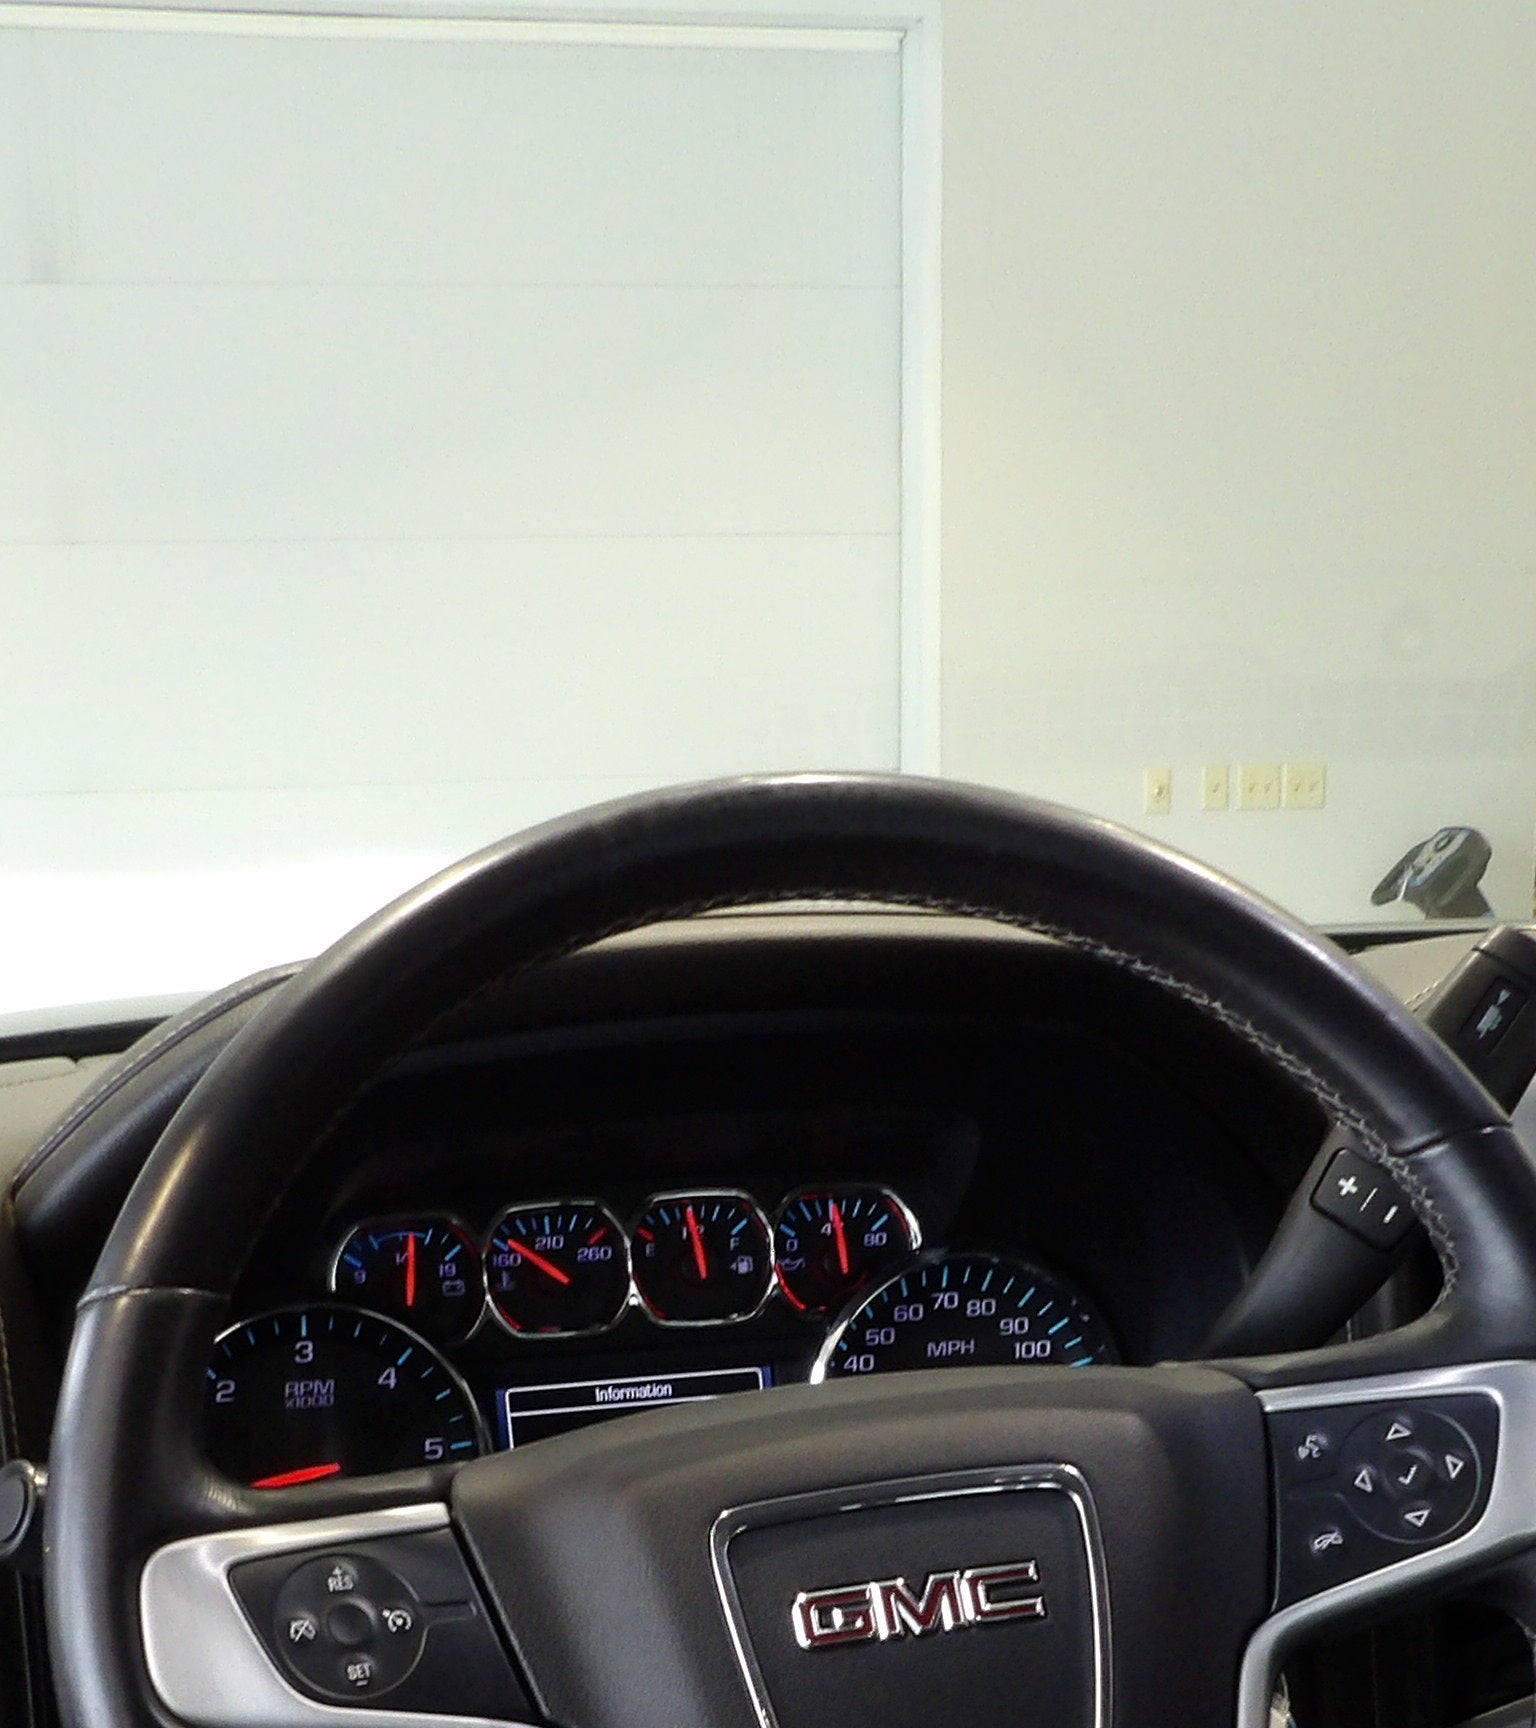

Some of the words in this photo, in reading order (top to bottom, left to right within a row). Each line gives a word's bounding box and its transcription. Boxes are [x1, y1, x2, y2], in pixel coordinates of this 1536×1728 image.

[535, 1234, 564, 1251] 210
[729, 1237, 740, 1251] F
[864, 1231, 887, 1247] 80
[577, 1246, 612, 1262] 260
[439, 1263, 457, 1278] 19
[930, 1291, 959, 1310] 70
[966, 1298, 996, 1317] 80
[894, 1303, 924, 1322] 60
[999, 1317, 1029, 1336] 90
[865, 1328, 896, 1346] 50
[294, 1340, 314, 1364] 3
[927, 1339, 975, 1358] MPH
[1013, 1340, 1051, 1359] 100
[844, 1354, 875, 1373] 40
[377, 1366, 398, 1390] 4
[215, 1380, 236, 1403] 2
[285, 1379, 335, 1398] RPM
[594, 1383, 673, 1402] Information
[424, 1437, 444, 1460] 5
[327, 1575, 354, 1593] RES
[791, 1561, 1046, 1650] GMC
[346, 1663, 372, 1682] SET
